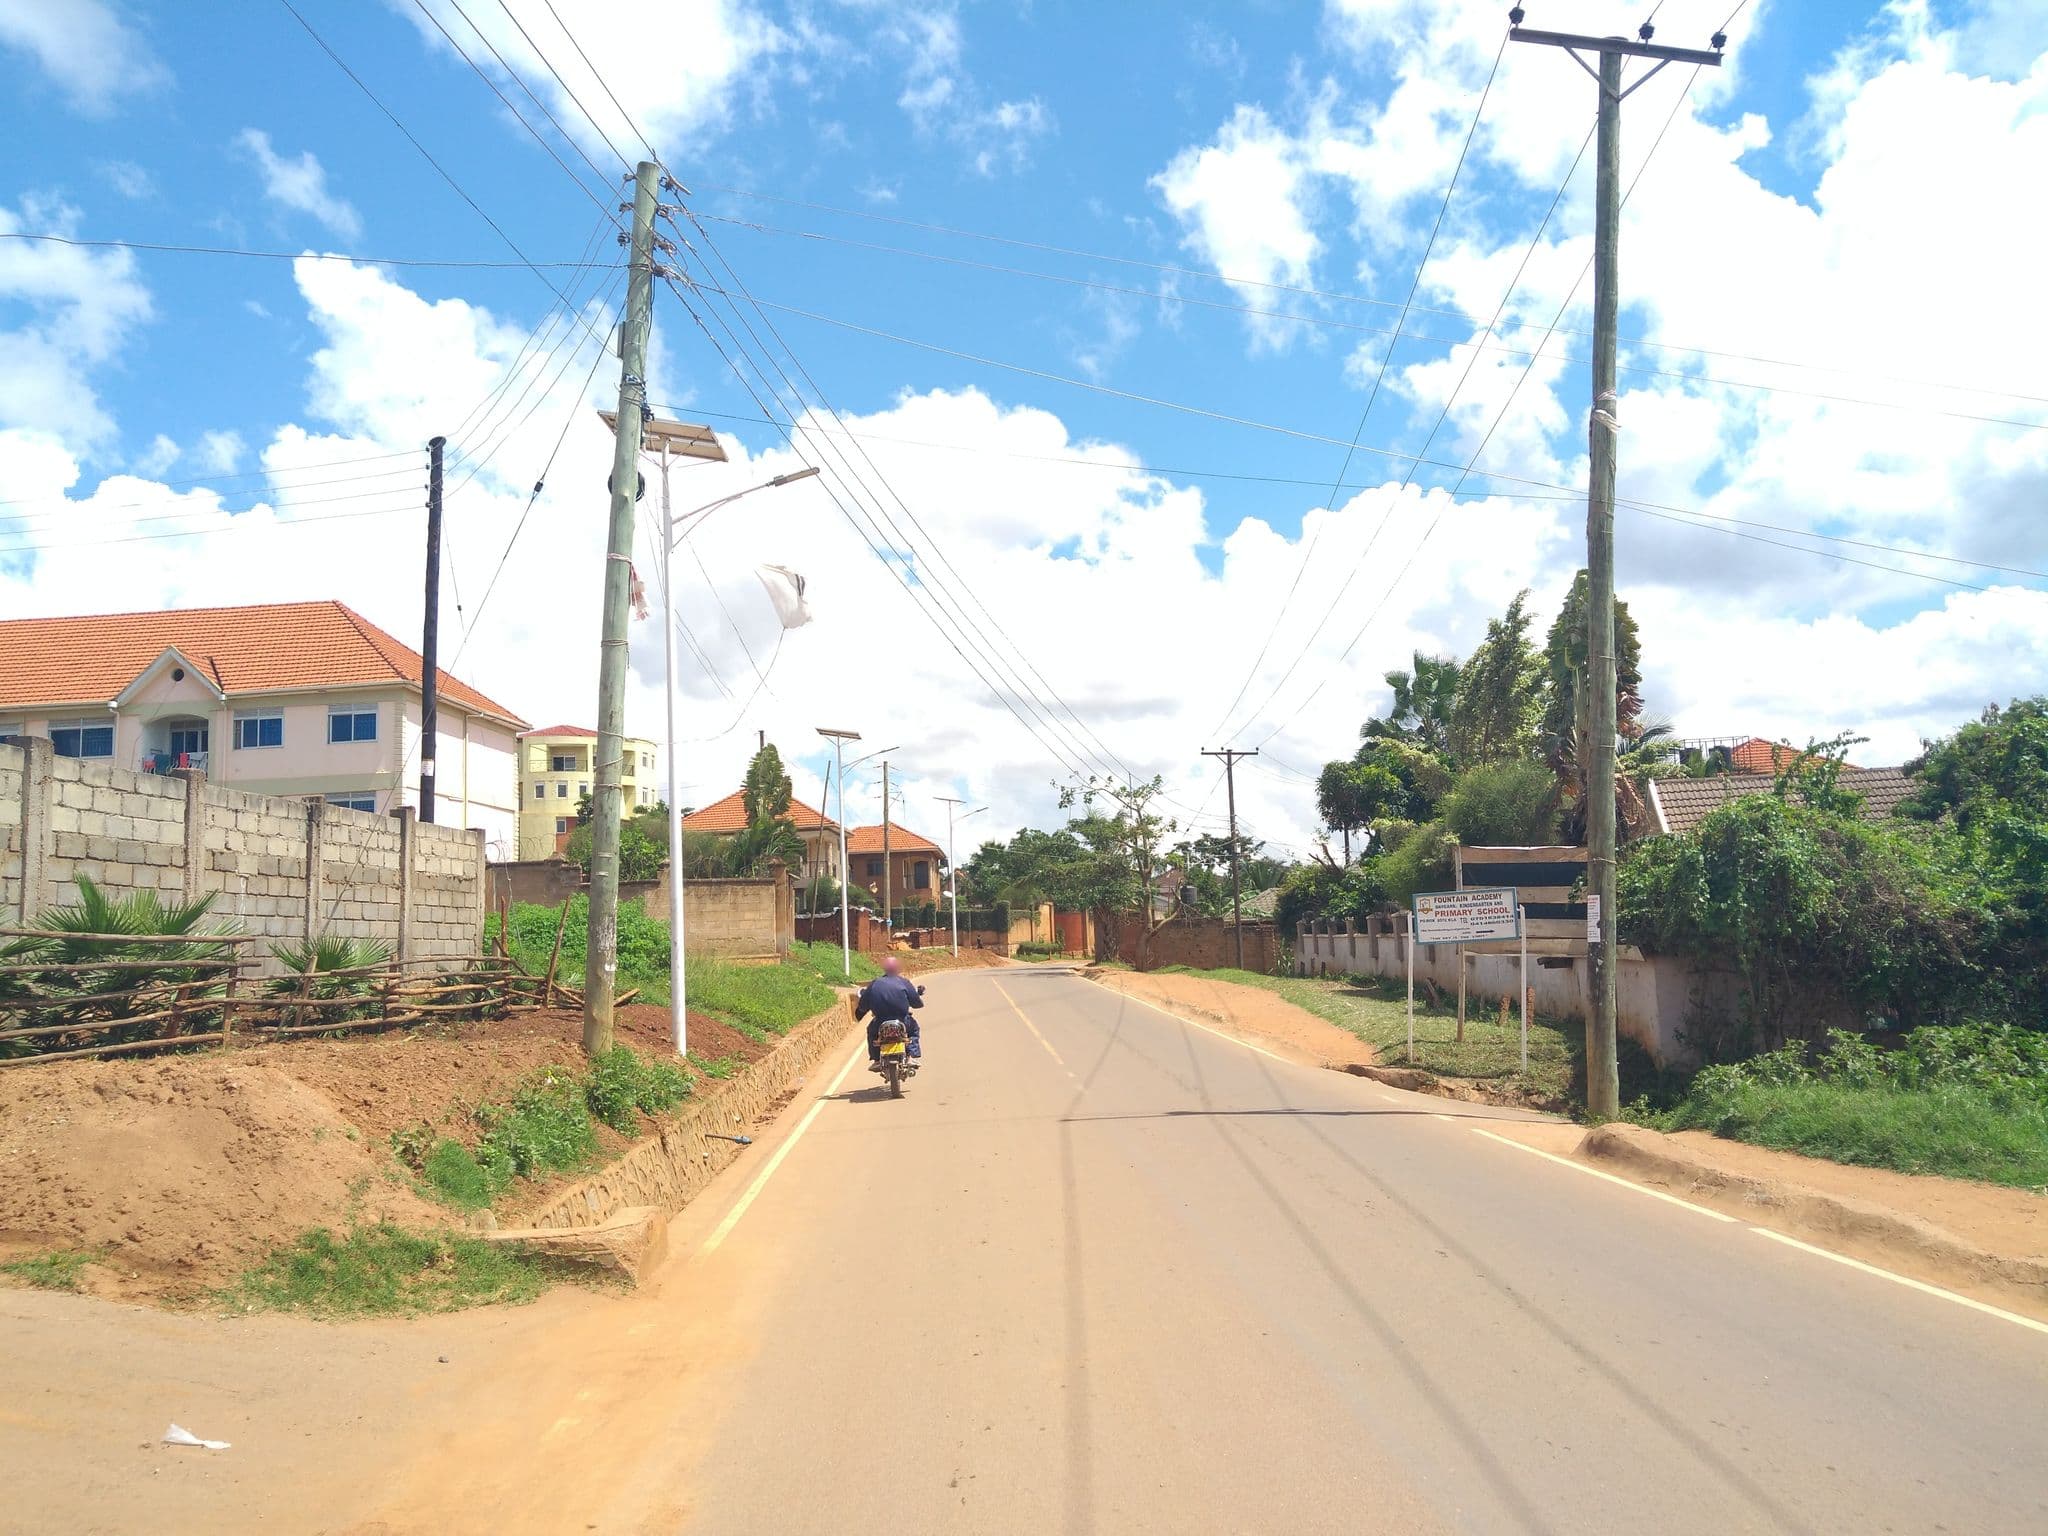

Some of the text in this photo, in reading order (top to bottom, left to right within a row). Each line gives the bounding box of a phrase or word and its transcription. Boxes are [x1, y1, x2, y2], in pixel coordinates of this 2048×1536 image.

[1434, 892, 1502, 904] FOUNTAIN ACADEMY
[1434, 906, 1510, 918] PRIMARY SCHOOL
